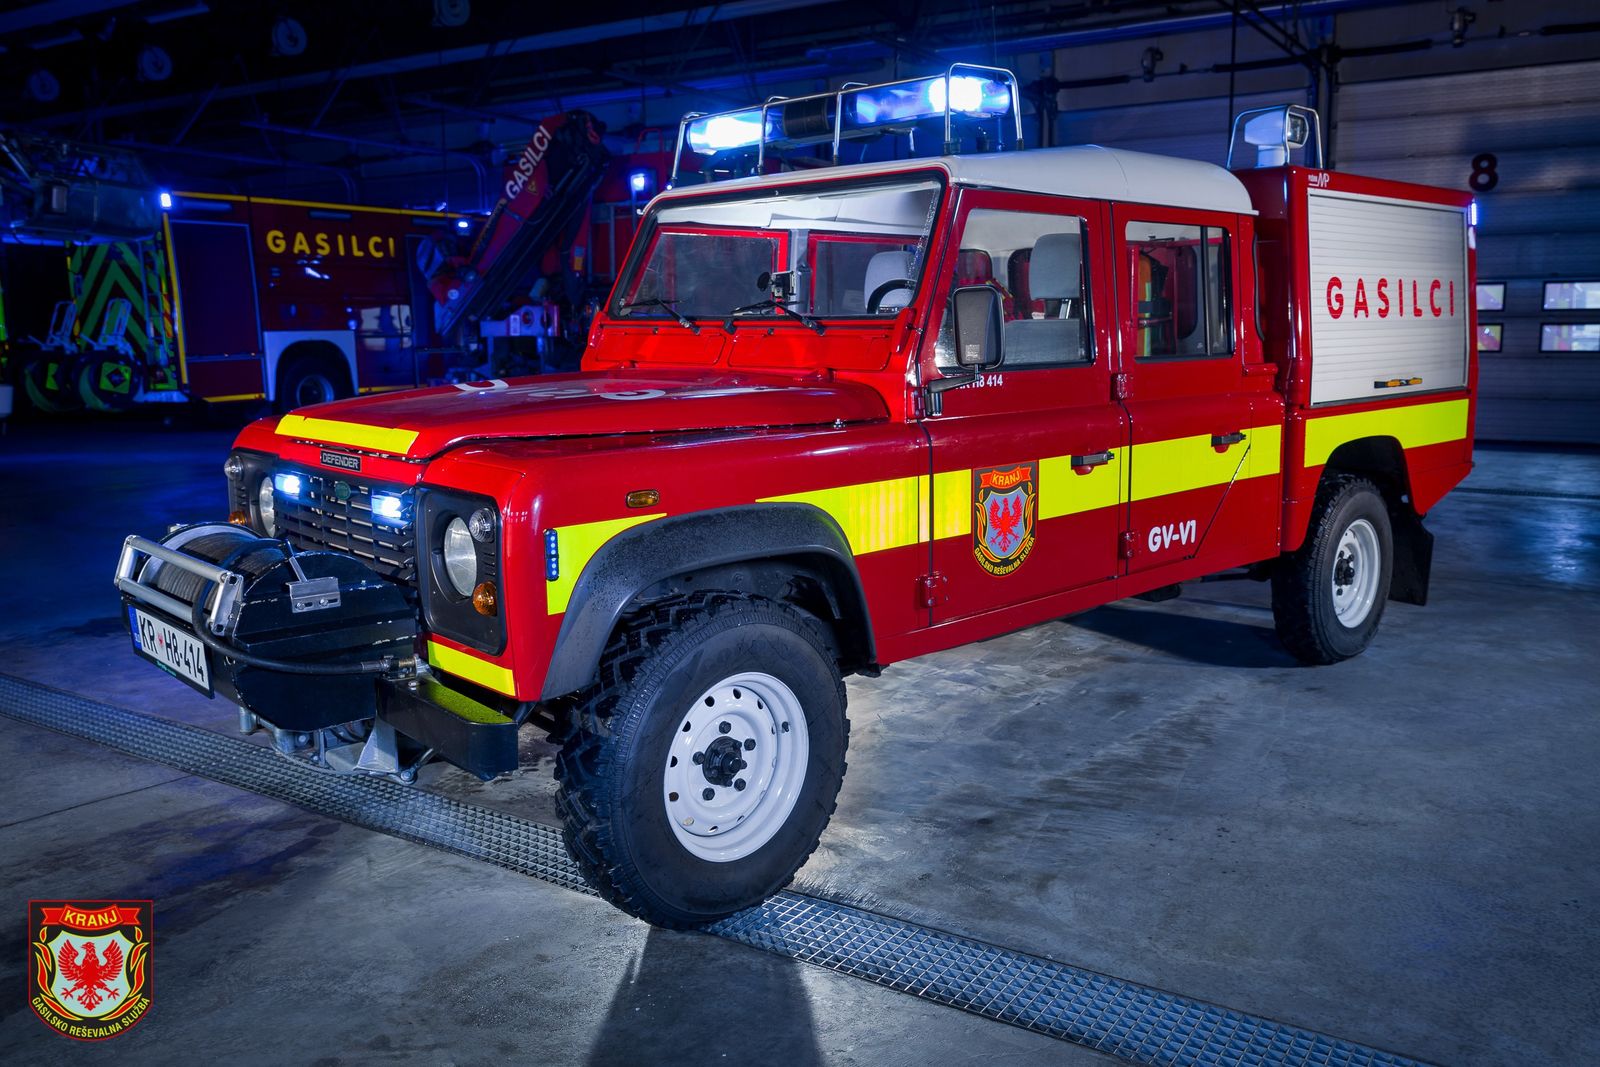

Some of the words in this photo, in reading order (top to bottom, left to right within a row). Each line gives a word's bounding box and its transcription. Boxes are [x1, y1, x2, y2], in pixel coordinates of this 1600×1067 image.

[505, 125, 552, 199] GASILCI
[1469, 153, 1498, 192] 8
[266, 230, 395, 258] GASILCI
[1327, 276, 1454, 319] GASILCI
[986, 374, 1003, 388] 414
[322, 452, 359, 469] DEFENDER
[992, 470, 1020, 485] KRANJ
[1148, 519, 1197, 553] GV-V1
[139, 615, 158, 655] KR
[163, 627, 205, 682] H8-414
